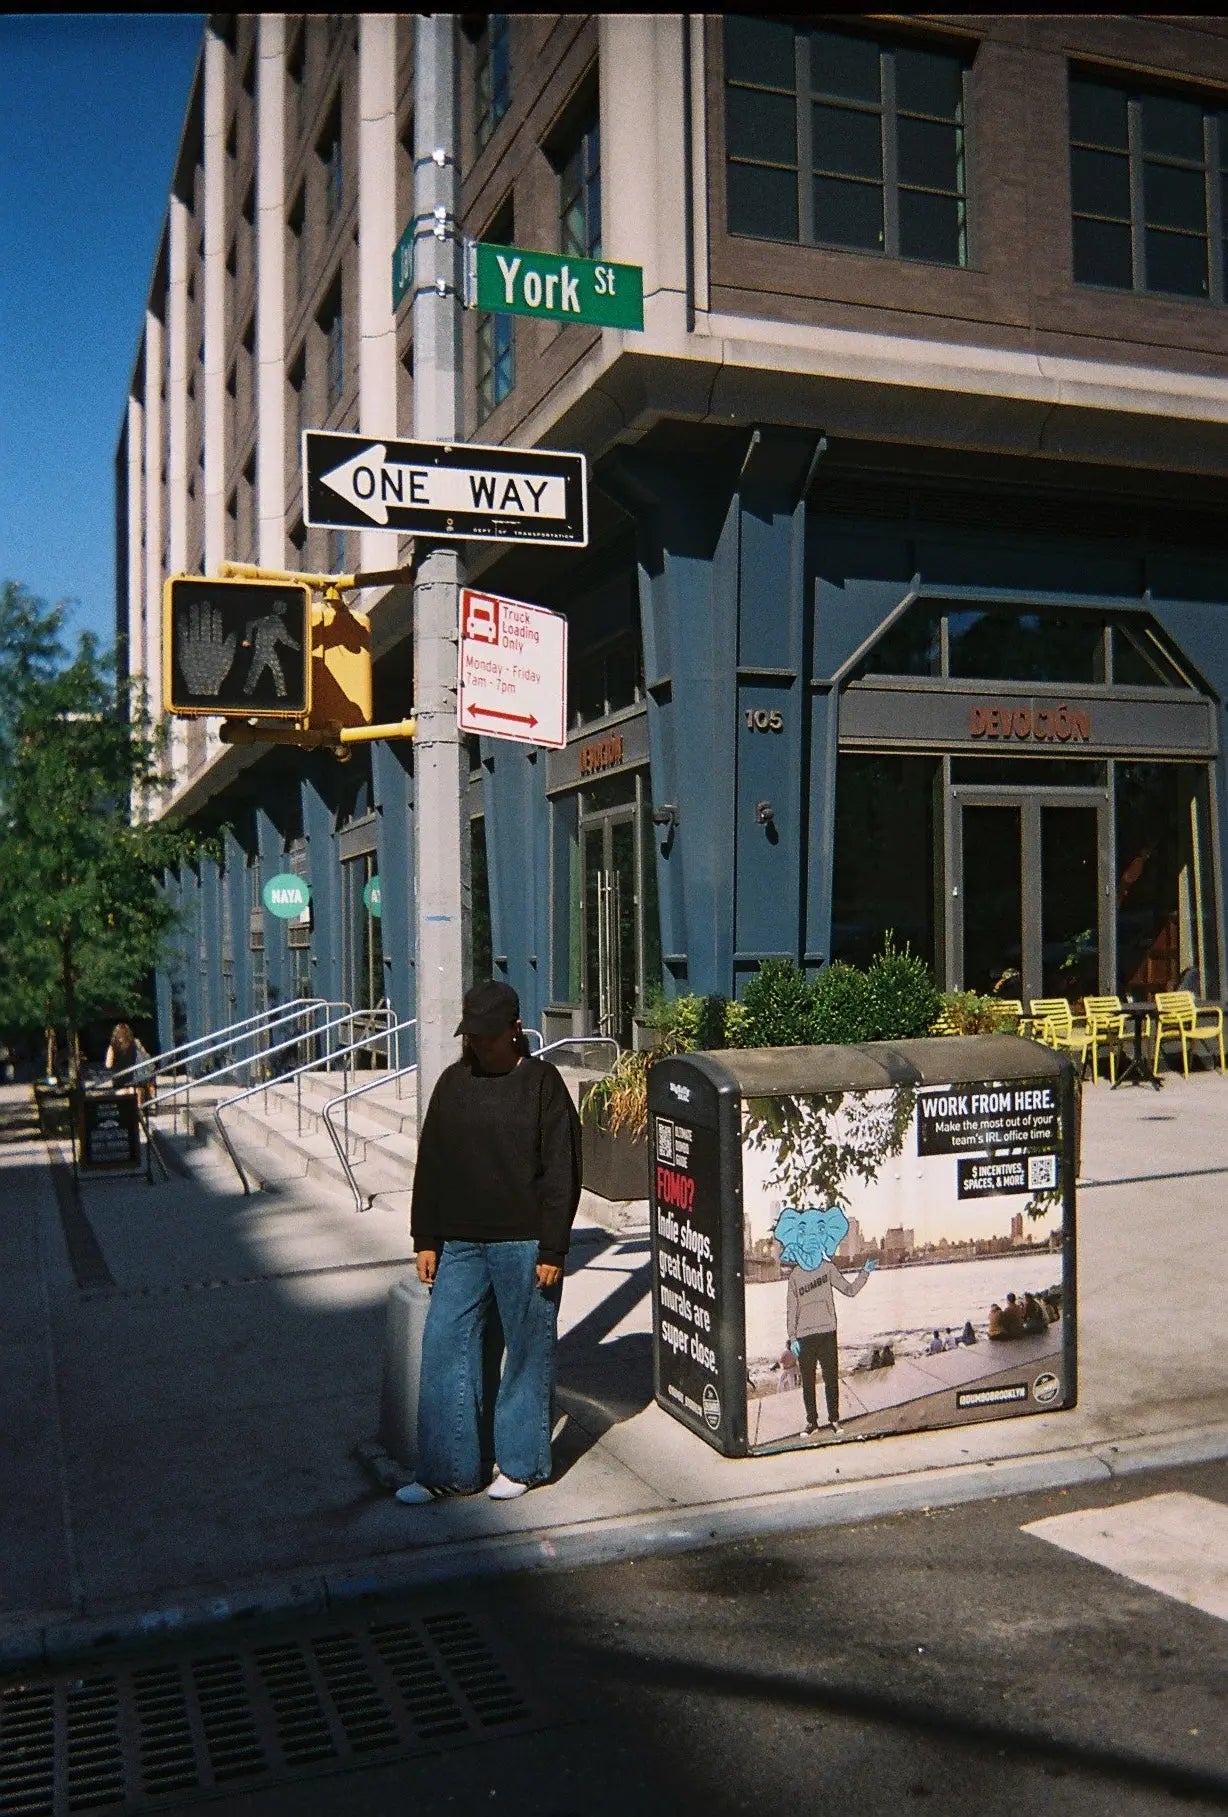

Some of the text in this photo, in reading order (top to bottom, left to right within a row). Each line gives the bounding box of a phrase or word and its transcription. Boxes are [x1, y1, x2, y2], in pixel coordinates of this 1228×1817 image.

[496, 255, 617, 313] York St
[352, 465, 548, 513] ONE WAY
[514, 530, 574, 539] TRANSPORTATION
[503, 606, 531, 625] Truck
[502, 621, 540, 643] Loading
[502, 636, 524, 653] Only
[465, 655, 502, 675] Monday
[512, 665, 541, 684] Friday
[466, 672, 487, 687] 7am
[496, 678, 516, 694] 7pm
[744, 709, 784, 732] 105
[969, 703, 1089, 740] DEVOCIÓN
[271, 889, 303, 904] NAYA
[922, 1089, 1055, 1118] WORK FROM HERE.
[935, 1114, 1053, 1133] Make the most out of your
[952, 1133, 984, 1146] team's
[985, 1131, 1001, 1143] IRL
[1003, 1129, 1029, 1142] office
[971, 1166, 977, 1178] $
[996, 1176, 1002, 1187] &
[1003, 1174, 1025, 1187] MORE
[657, 1166, 695, 1213] FOMO?
[657, 1206, 713, 1263] Indie shops,
[659, 1249, 716, 1300] great food &
[798, 1273, 829, 1296] DUMBO
[660, 1284, 711, 1332] murals are
[661, 1320, 718, 1375] super close.
